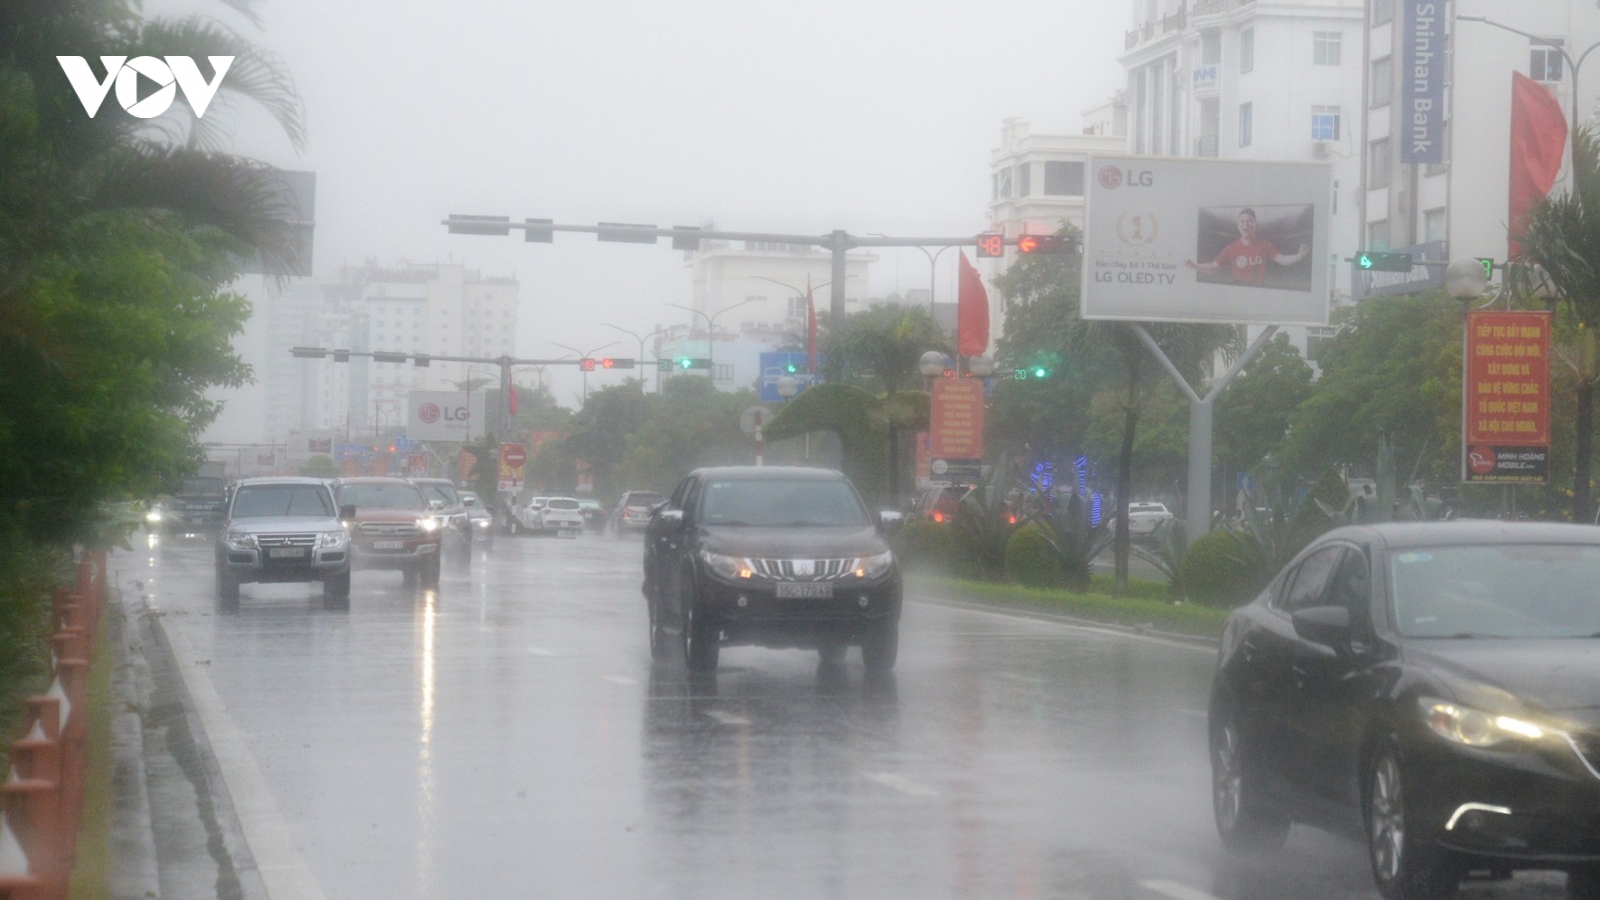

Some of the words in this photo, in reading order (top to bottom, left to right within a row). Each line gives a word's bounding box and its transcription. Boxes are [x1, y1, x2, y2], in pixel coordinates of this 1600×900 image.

[1415, 4, 1435, 92] Shinhan
[1413, 98, 1432, 153] Bank
[1127, 170, 1153, 187] LG
[1131, 215, 1142, 239] 1
[978, 236, 1001, 256] 48
[1249, 256, 1263, 266] LG
[1095, 271, 1112, 283] LG
[1117, 272, 1153, 284] OLED
[1158, 273, 1175, 285] TV
[445, 406, 467, 421] LG
